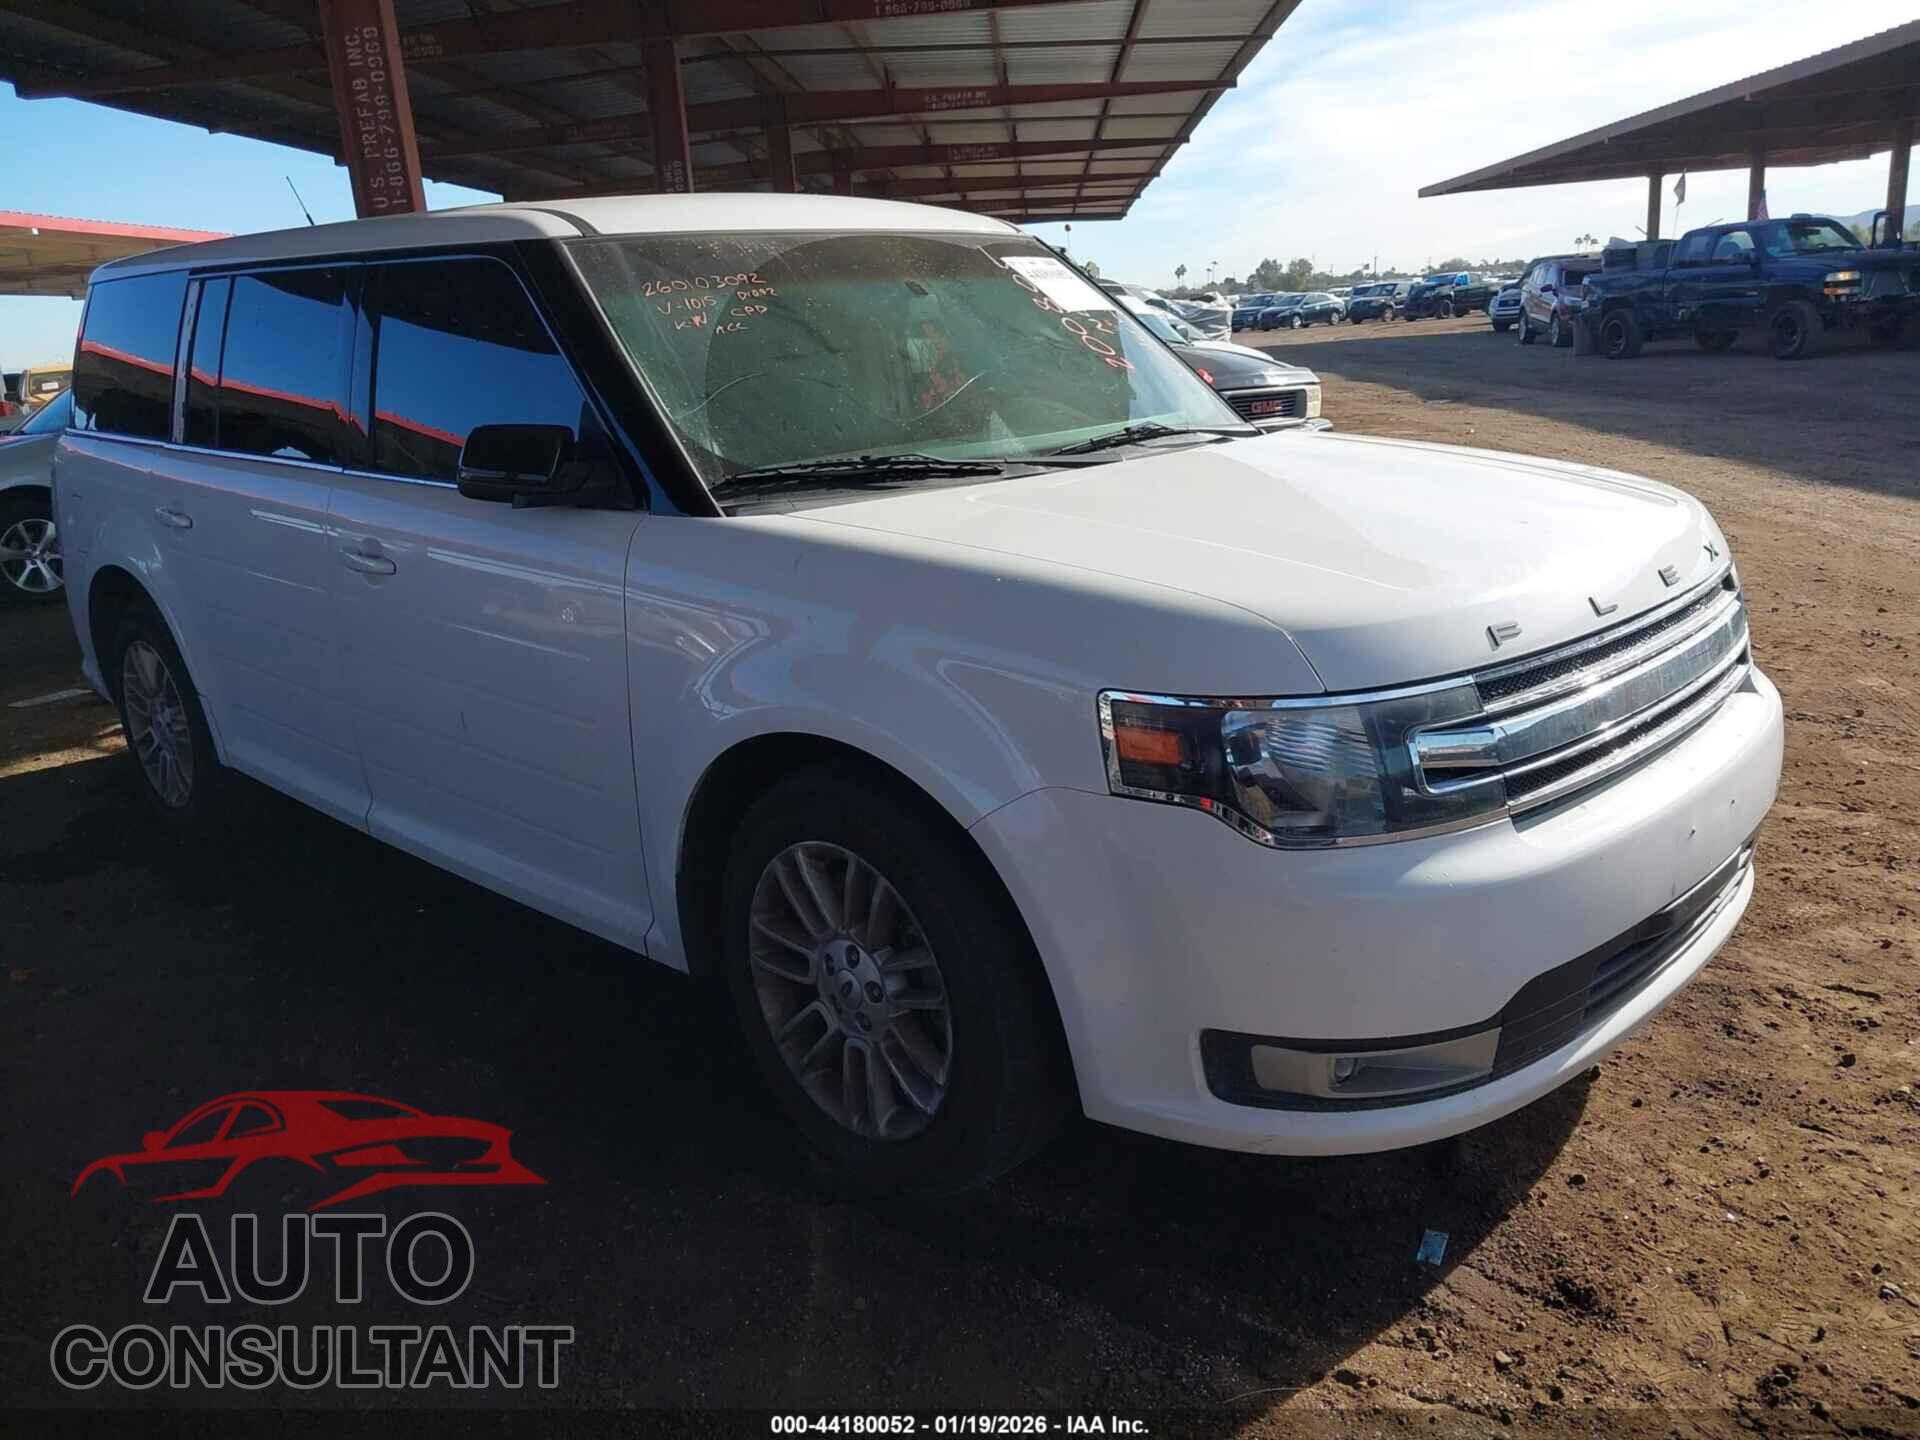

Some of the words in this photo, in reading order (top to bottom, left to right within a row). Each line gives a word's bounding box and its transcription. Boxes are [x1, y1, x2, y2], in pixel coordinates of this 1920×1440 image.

[352, 78, 380, 159] PREFAB
[642, 273, 767, 297] 260103092
[1251, 400, 1282, 415] GMC
[1485, 540, 1719, 651] FLEX
